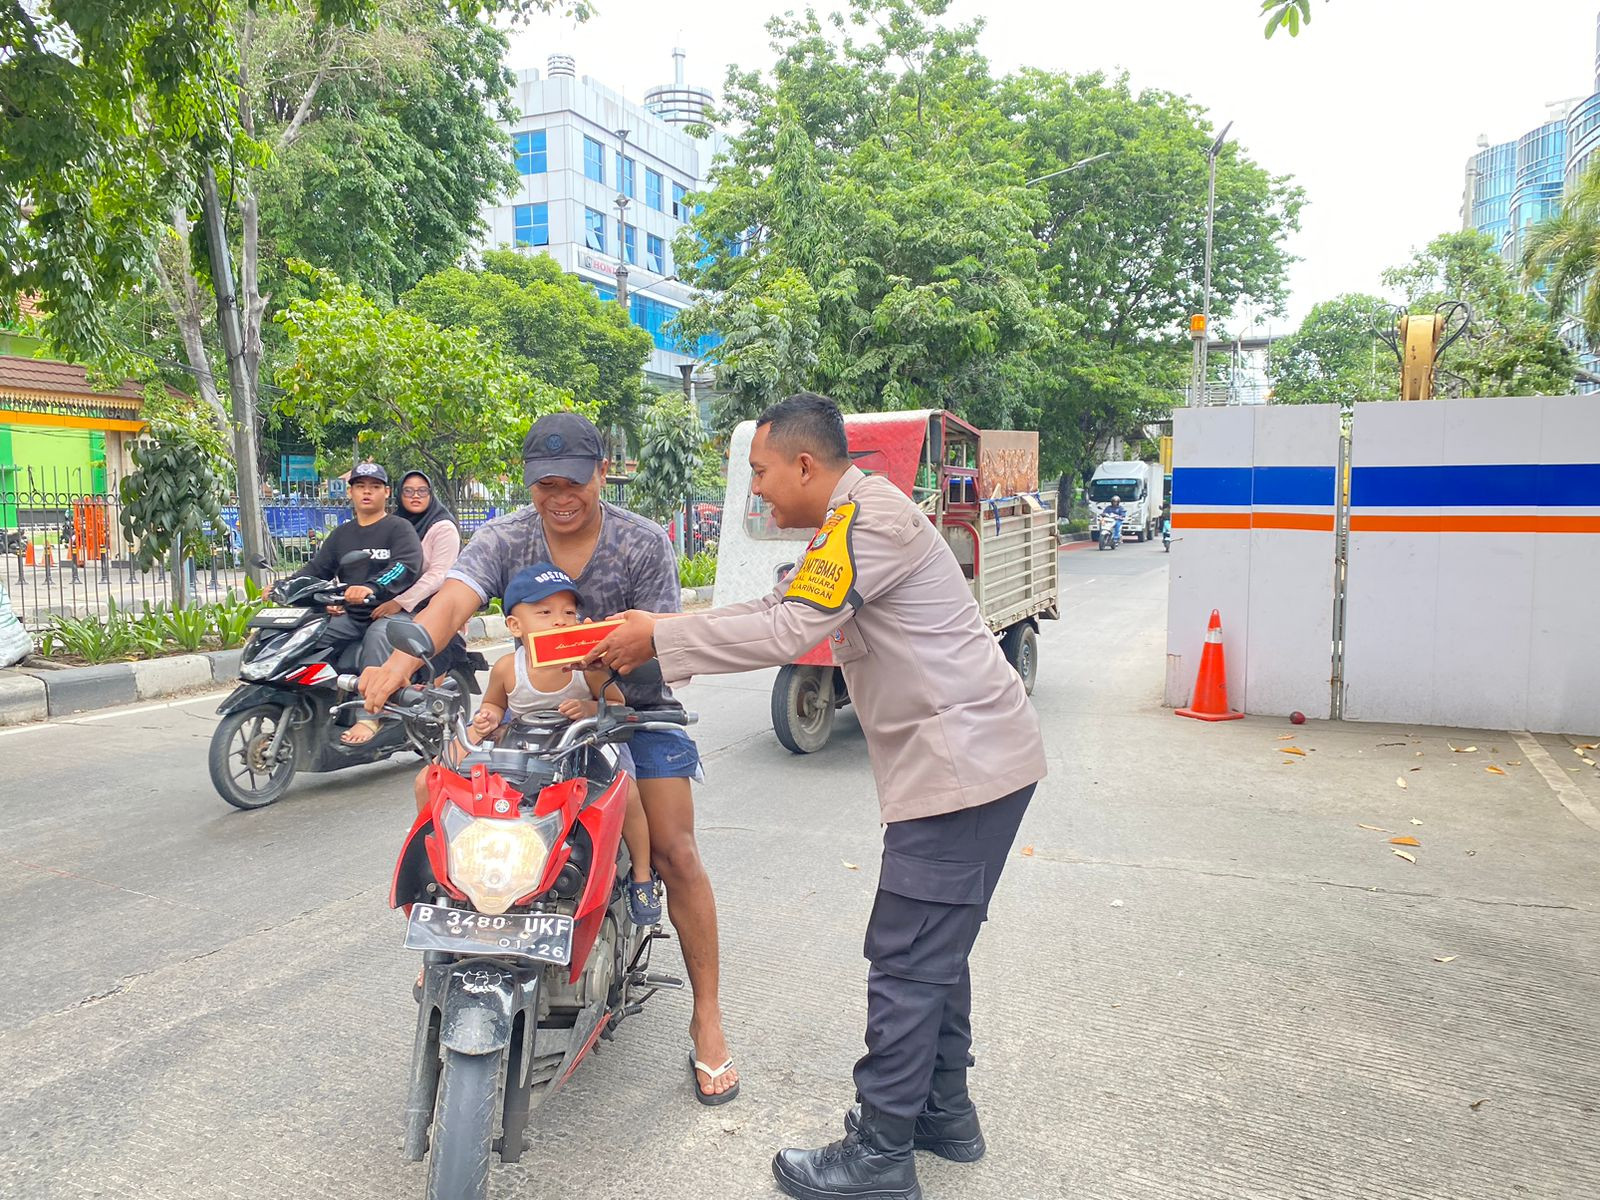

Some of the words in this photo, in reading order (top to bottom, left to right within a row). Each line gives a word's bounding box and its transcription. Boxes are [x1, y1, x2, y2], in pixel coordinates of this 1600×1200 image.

[808, 575, 834, 590] MUARA
[418, 906, 434, 922] B
[446, 911, 506, 930] 3480
[524, 917, 570, 936] UKF
